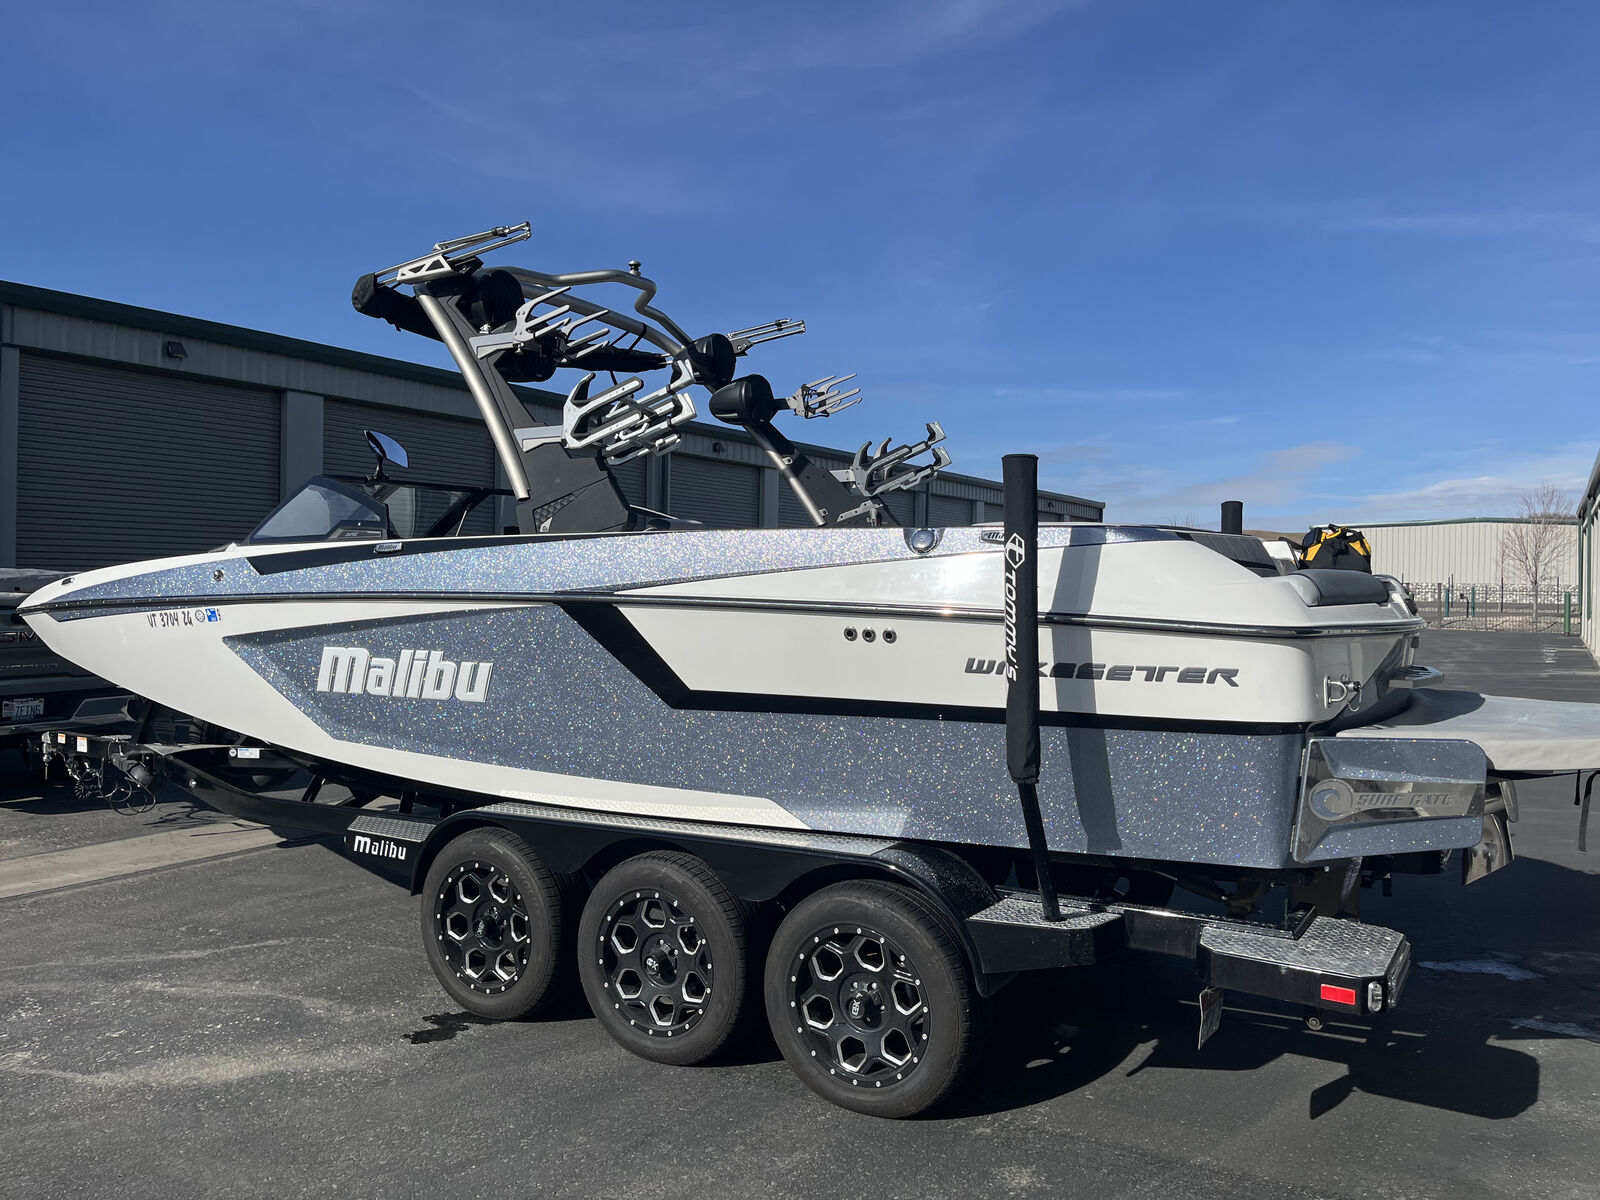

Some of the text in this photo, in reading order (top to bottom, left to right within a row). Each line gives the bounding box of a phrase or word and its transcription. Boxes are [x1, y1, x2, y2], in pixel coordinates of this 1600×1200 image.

[147, 613, 157, 628] UT
[160, 611, 179, 627] 3704
[317, 646, 494, 703] Malibu
[1357, 793, 1403, 806] SURF
[353, 835, 406, 860] Malibu
